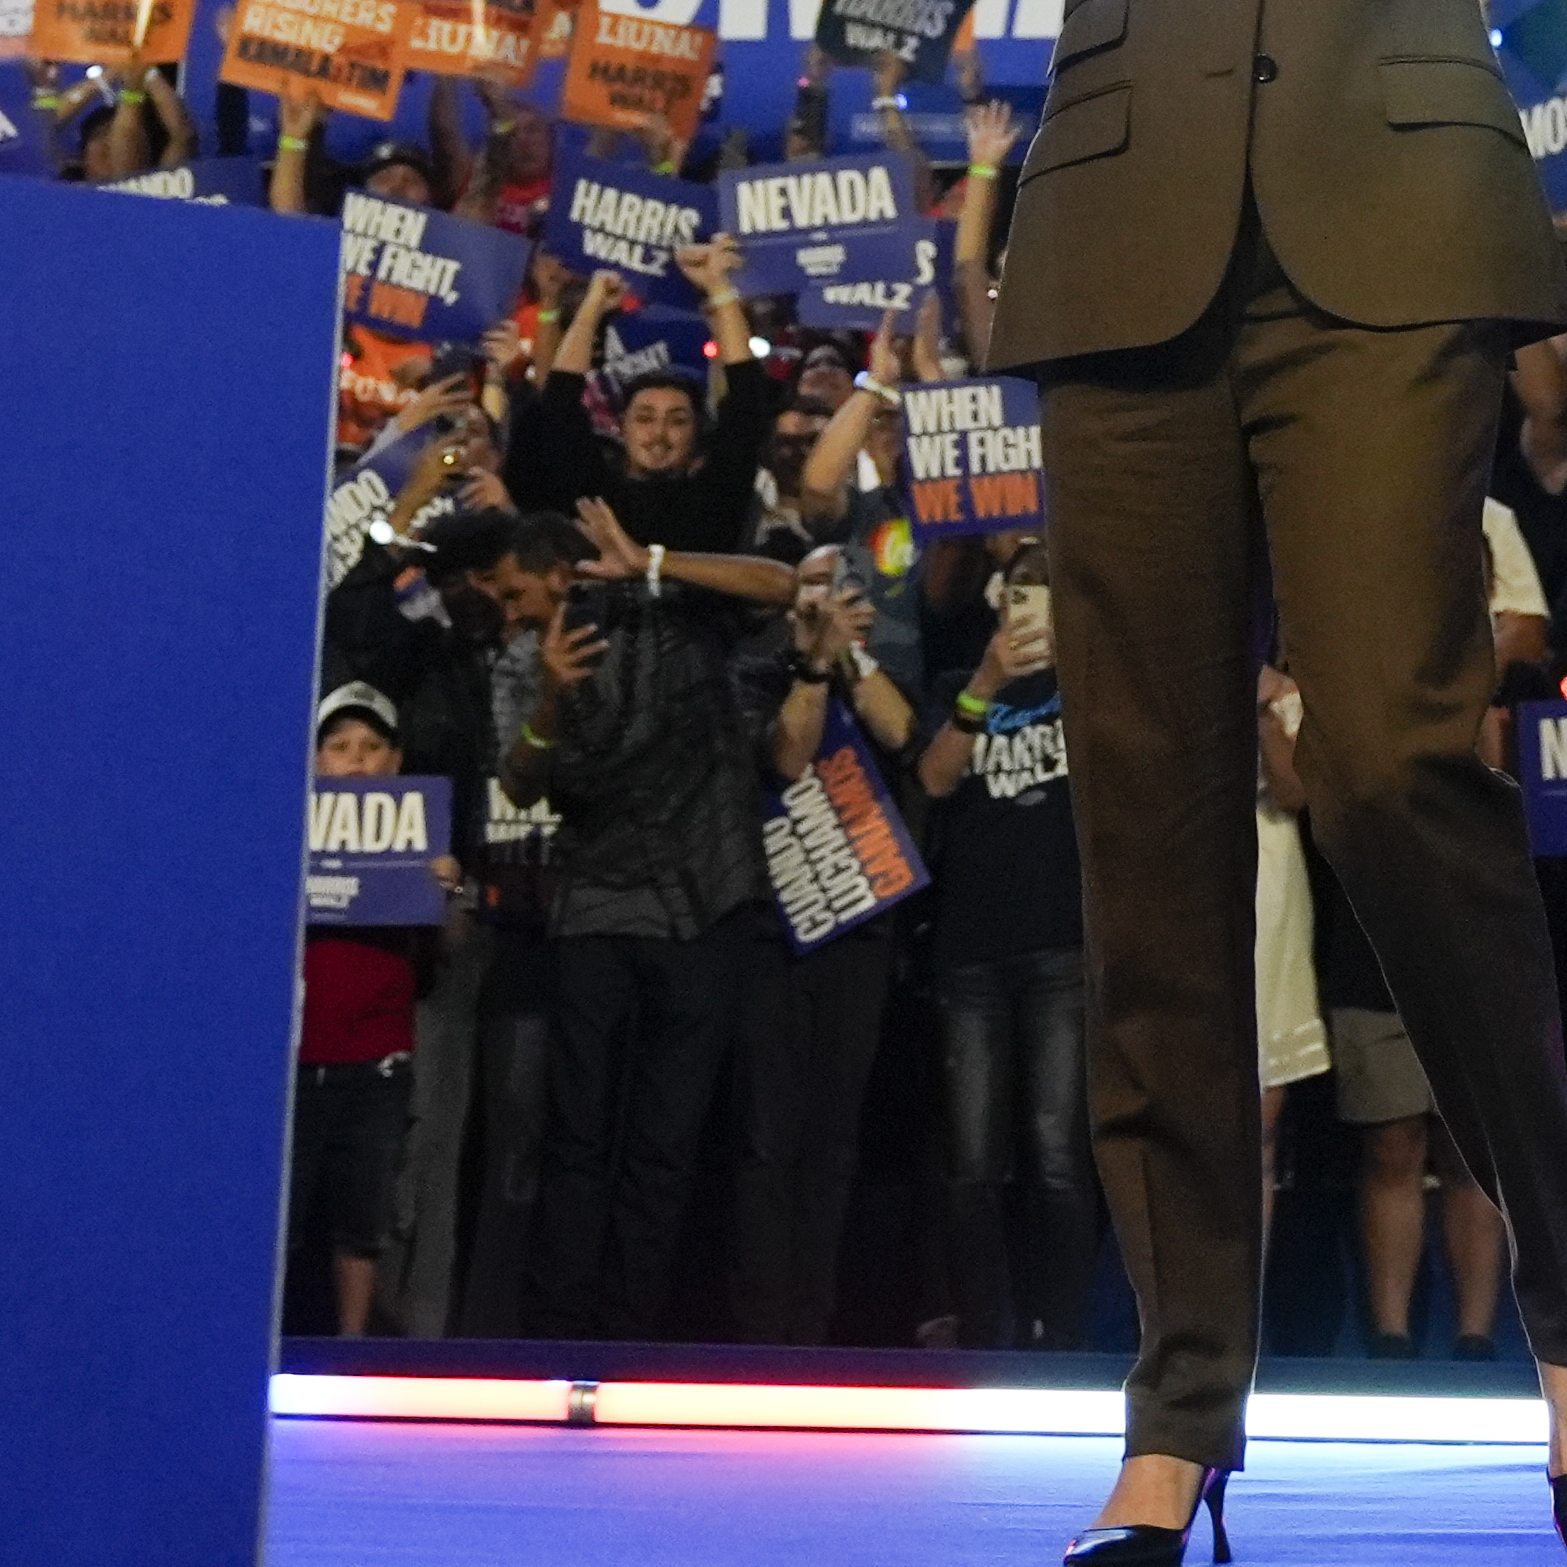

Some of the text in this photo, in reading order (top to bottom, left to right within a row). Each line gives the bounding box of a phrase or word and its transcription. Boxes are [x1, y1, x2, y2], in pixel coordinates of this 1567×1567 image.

[342, 191, 429, 251] WHEN
[569, 177, 702, 248] HARRIS
[735, 165, 899, 235] NEVADA
[582, 229, 675, 278] WALZ
[904, 384, 1004, 435] WHEN
[905, 432, 964, 481] WE
[780, 762, 879, 924] LUCHAMO
